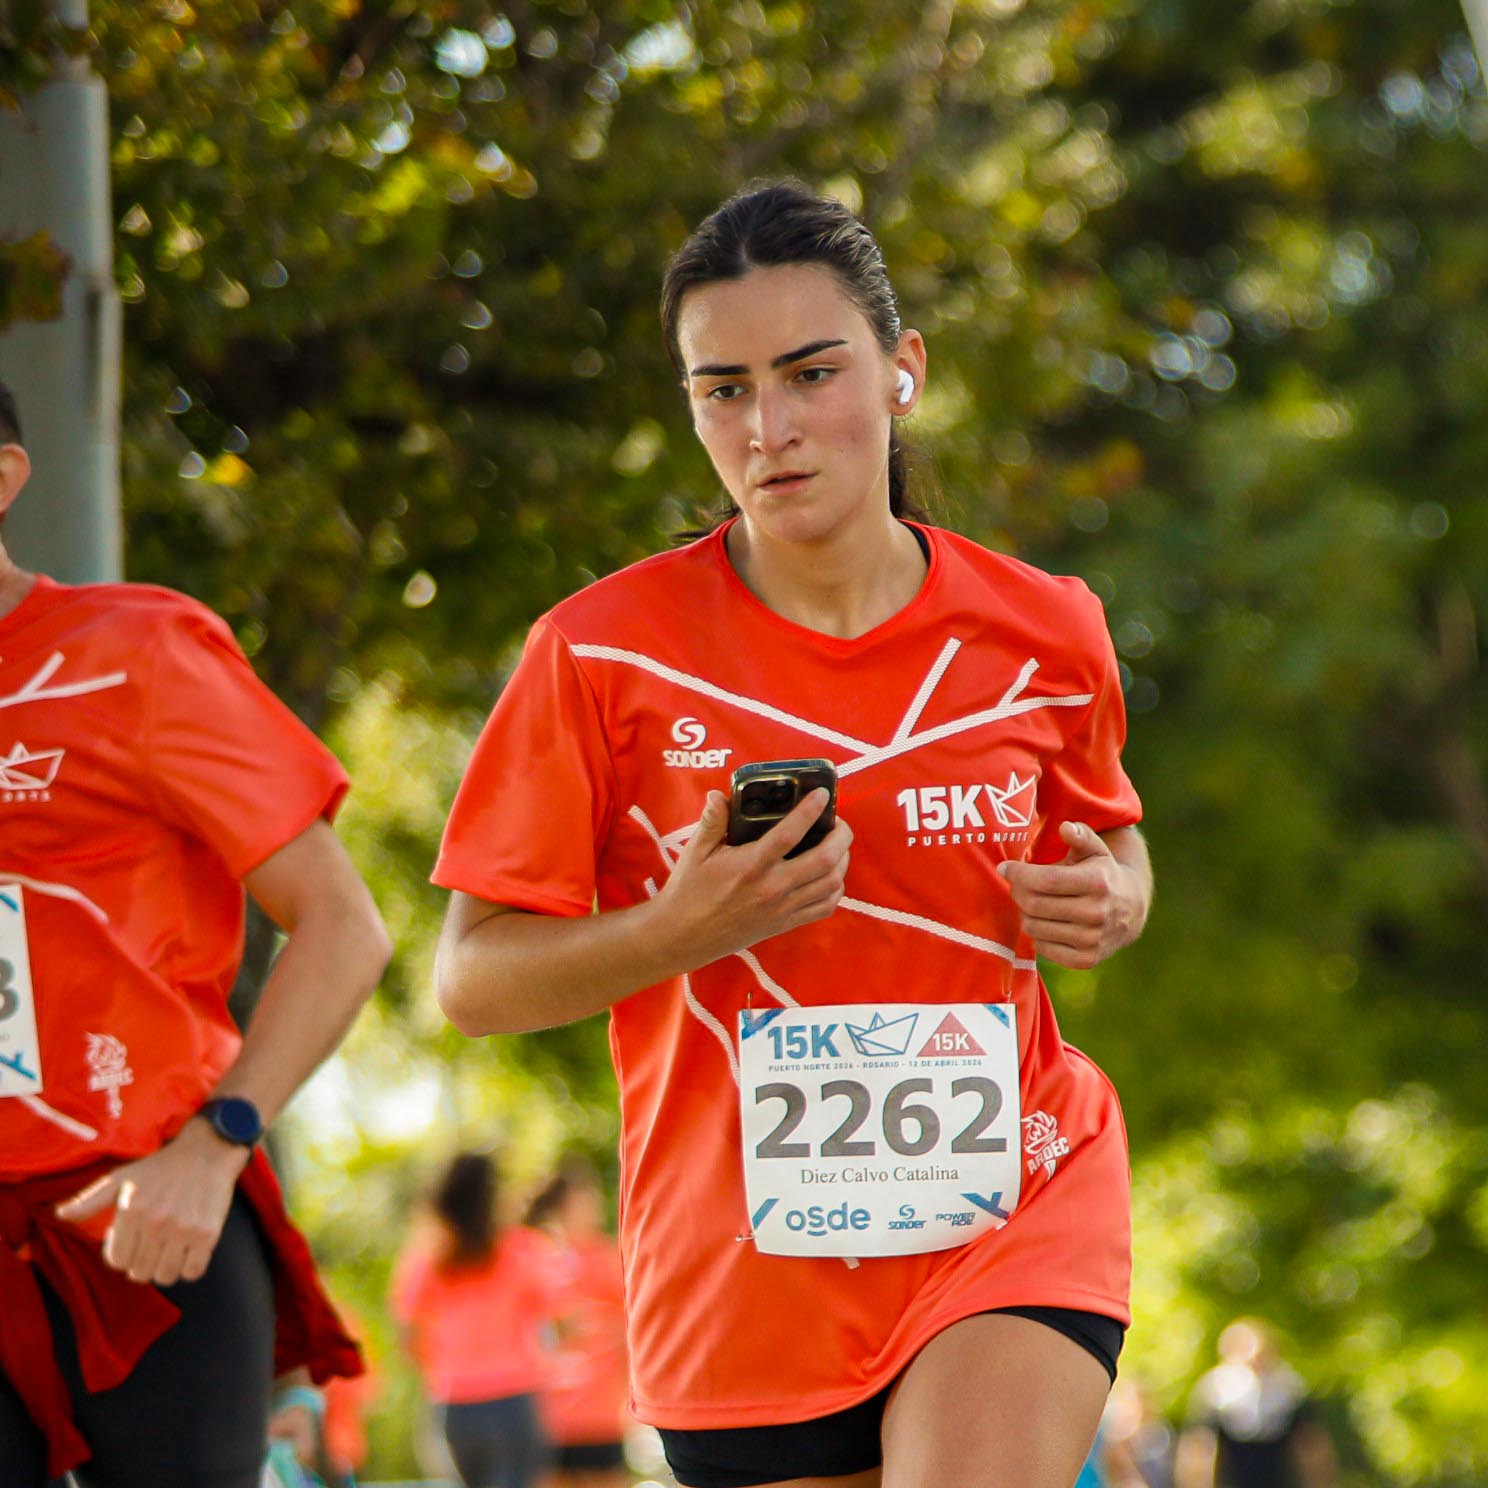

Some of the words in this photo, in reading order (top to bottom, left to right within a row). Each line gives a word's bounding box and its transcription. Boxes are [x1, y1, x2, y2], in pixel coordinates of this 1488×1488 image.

[897, 784, 985, 831] 15K
[908, 832, 985, 847] PUERTO
[994, 831, 1027, 843] NORTE
[768, 1023, 841, 1060] 15K
[932, 1033, 971, 1051] 15K
[769, 1064, 800, 1072] PUERTO
[804, 1062, 830, 1071] NORTE
[756, 1076, 1008, 1159] 2262
[800, 1168, 837, 1184] Diez
[842, 1166, 889, 1183] Calvo
[893, 1165, 959, 1181] Catalina
[785, 1201, 871, 1236] osde
